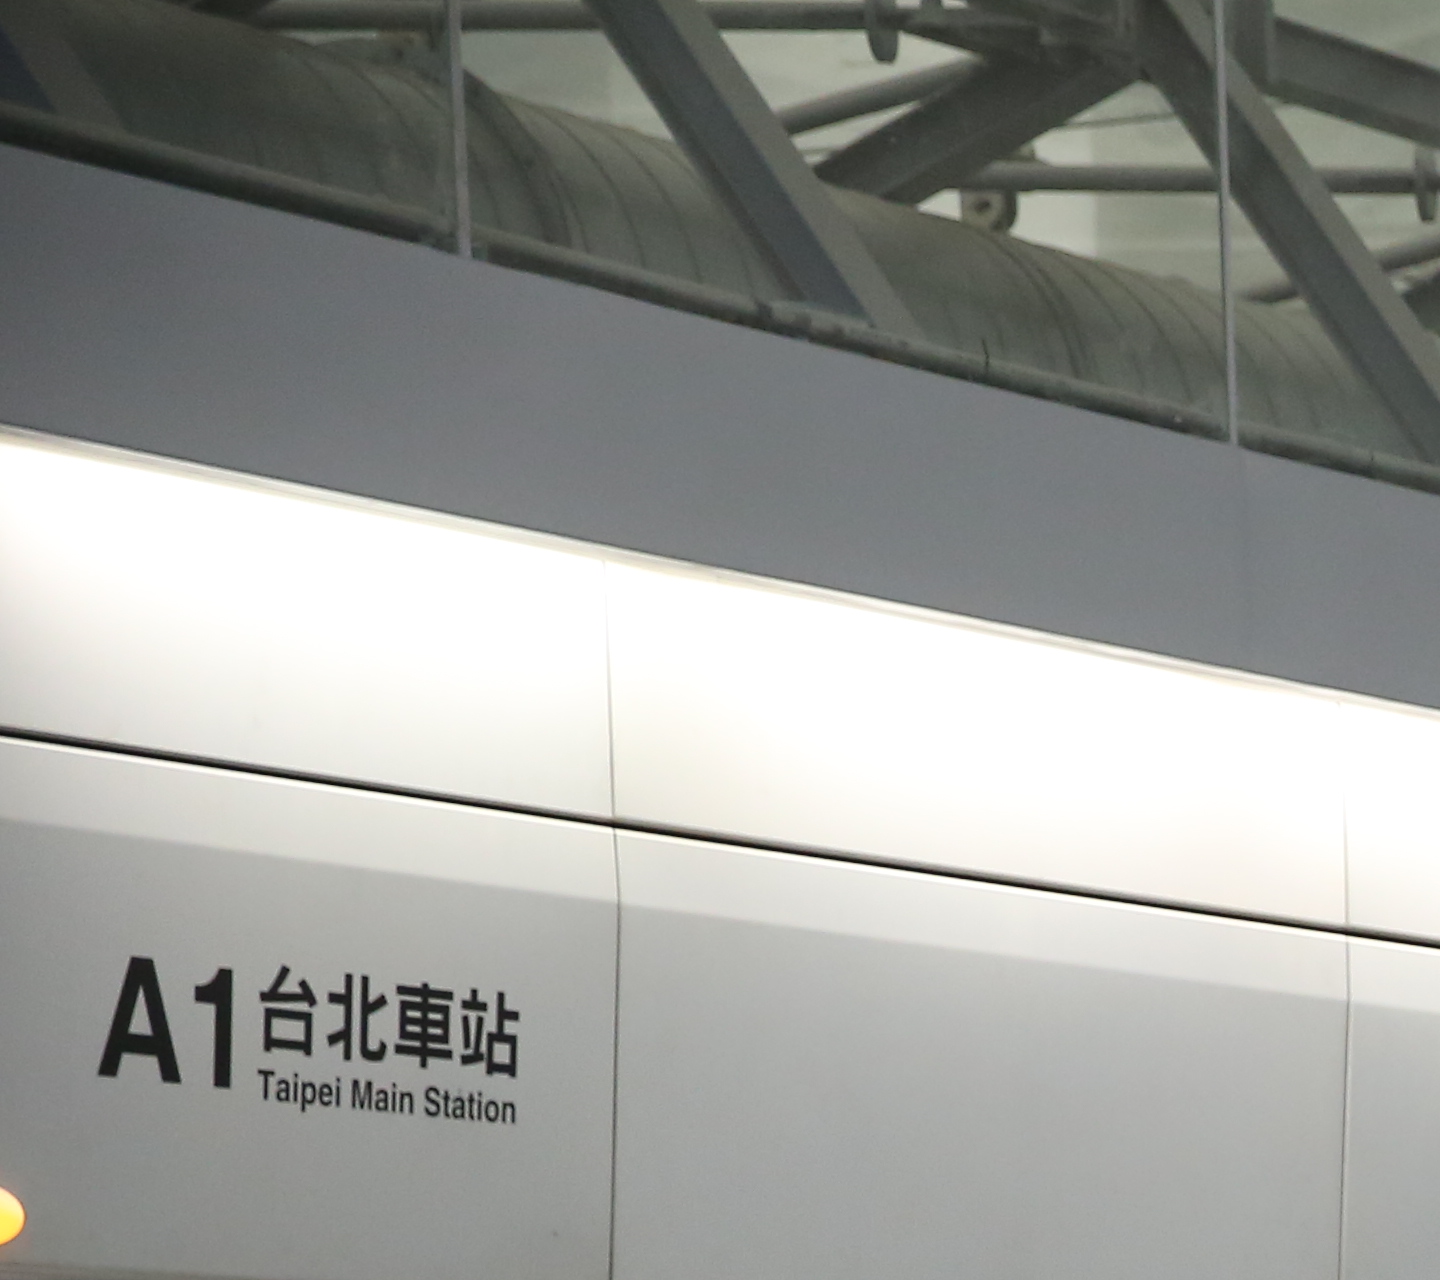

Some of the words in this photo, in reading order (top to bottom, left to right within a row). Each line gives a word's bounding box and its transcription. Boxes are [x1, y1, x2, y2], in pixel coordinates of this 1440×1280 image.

[98, 955, 233, 1089] A1
[258, 965, 520, 1078] 台北車站
[257, 1069, 341, 1112] Taipei
[351, 1078, 414, 1115] Main
[424, 1087, 517, 1124] Station
